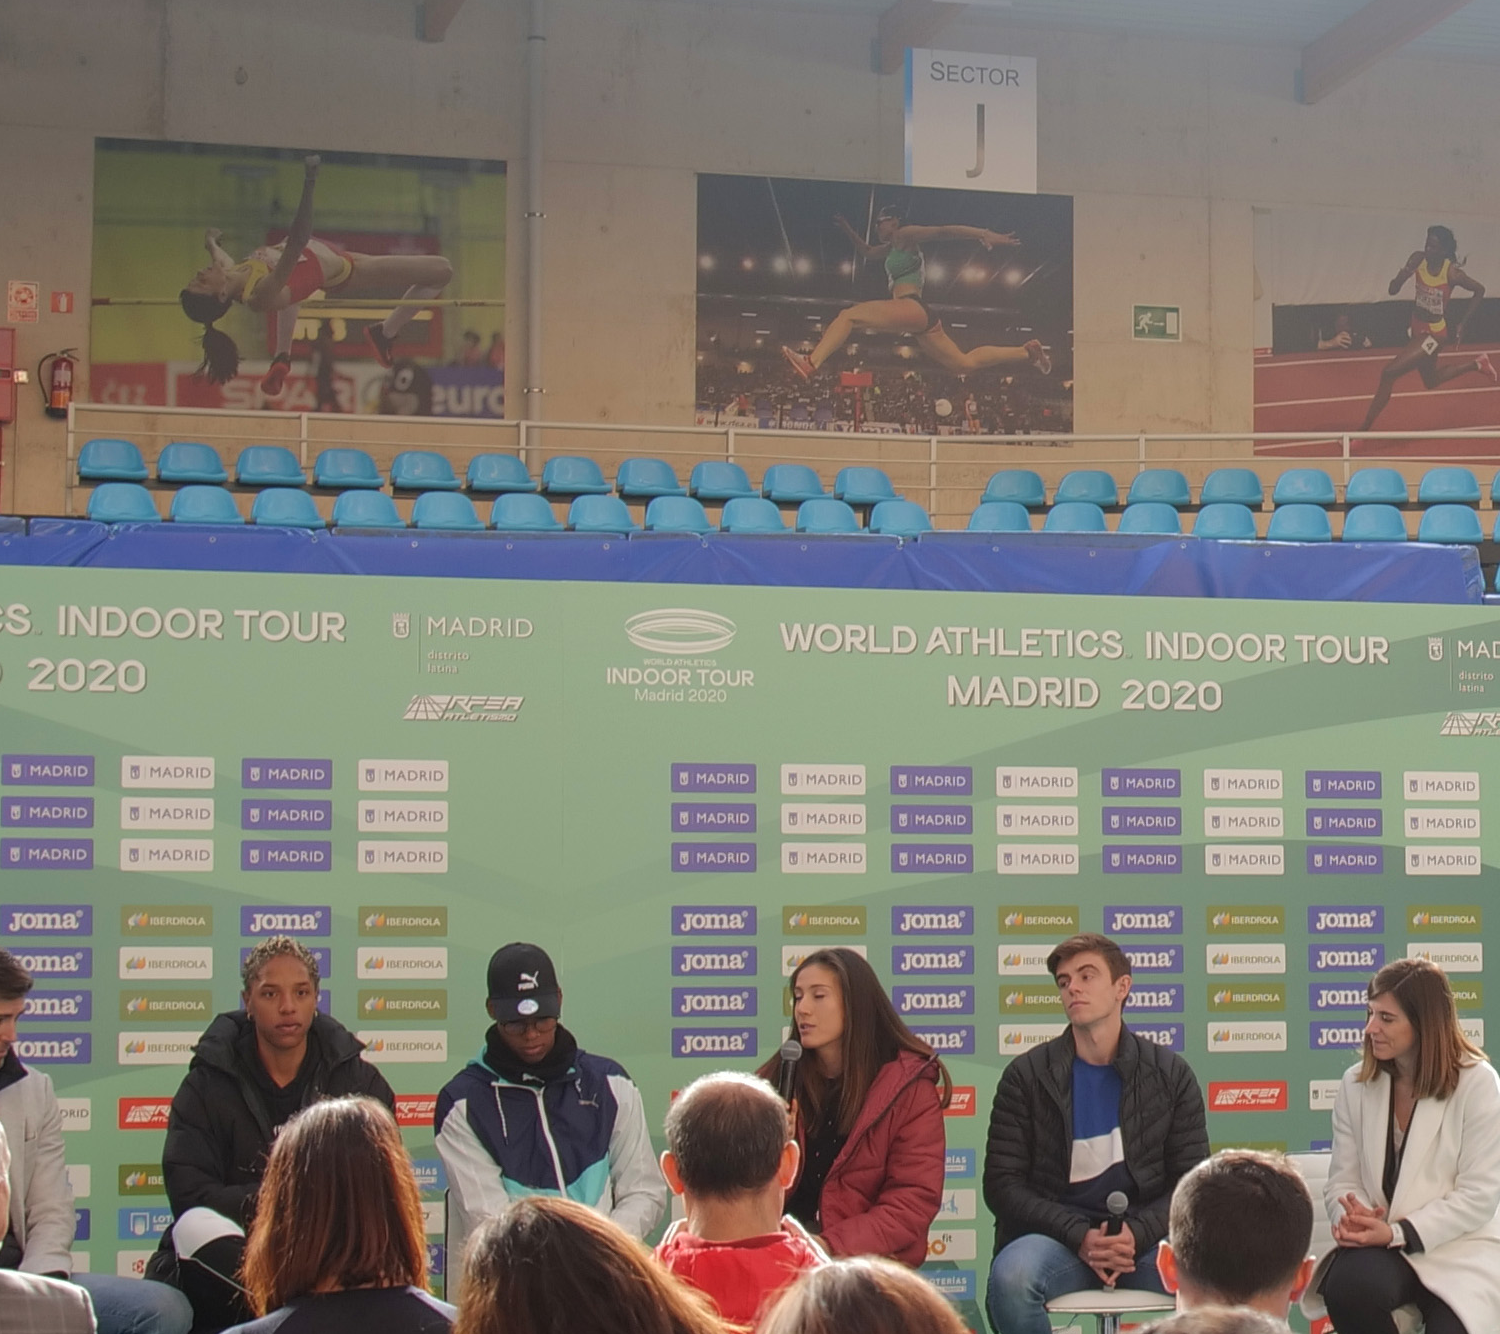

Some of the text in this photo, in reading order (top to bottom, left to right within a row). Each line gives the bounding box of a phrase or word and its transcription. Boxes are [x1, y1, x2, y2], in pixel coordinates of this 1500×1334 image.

[965, 103, 985, 178] J
[58, 605, 224, 639] INDOOR
[234, 609, 346, 642] TOUR
[427, 617, 534, 639] MADRID
[780, 623, 1389, 664] WORLD ATHLETICS INDOOR TOUR
[428, 650, 470, 661] distrito
[643, 658, 717, 667] WORLD ATHLETICS
[27, 658, 147, 693] 2020
[428, 663, 458, 674] latina
[1459, 670, 1494, 681] distrito
[606, 667, 755, 686] INDOOR TOUR
[635, 687, 727, 703] Madrid 2020
[947, 675, 1223, 711] MADRID 2020
[1459, 683, 1485, 693] latina
[447, 695, 526, 711] RFEA
[30, 764, 88, 778] MADRID
[150, 766, 211, 780] MADRID
[268, 767, 325, 781] MADRID
[384, 769, 444, 783] MADRID
[696, 772, 749, 785] MADRID
[806, 773, 862, 786] MADRID
[915, 774, 966, 788] MADRID
[1020, 775, 1074, 788] MADRID
[1126, 777, 1176, 790] MADRID
[1227, 778, 1280, 791] MADRID
[1328, 779, 1376, 792] MADRID
[1426, 780, 1476, 793] MADRID
[28, 848, 87, 862] MADRID
[9, 911, 79, 932] Joma
[150, 916, 206, 927] IBERDROLA
[250, 912, 319, 932] Joma
[386, 916, 441, 927] IBERDROLA
[681, 912, 745, 931] Joma
[809, 916, 860, 926] IBERDROLA
[900, 912, 961, 931] Joma
[1023, 916, 1073, 926] IBERDROLA
[1112, 911, 1172, 930] Joma
[1231, 916, 1279, 926] IBERDROLA
[1316, 911, 1374, 929] Joma
[1430, 915, 1476, 924] IBERDROLA
[942, 1234, 952, 1243] fit
